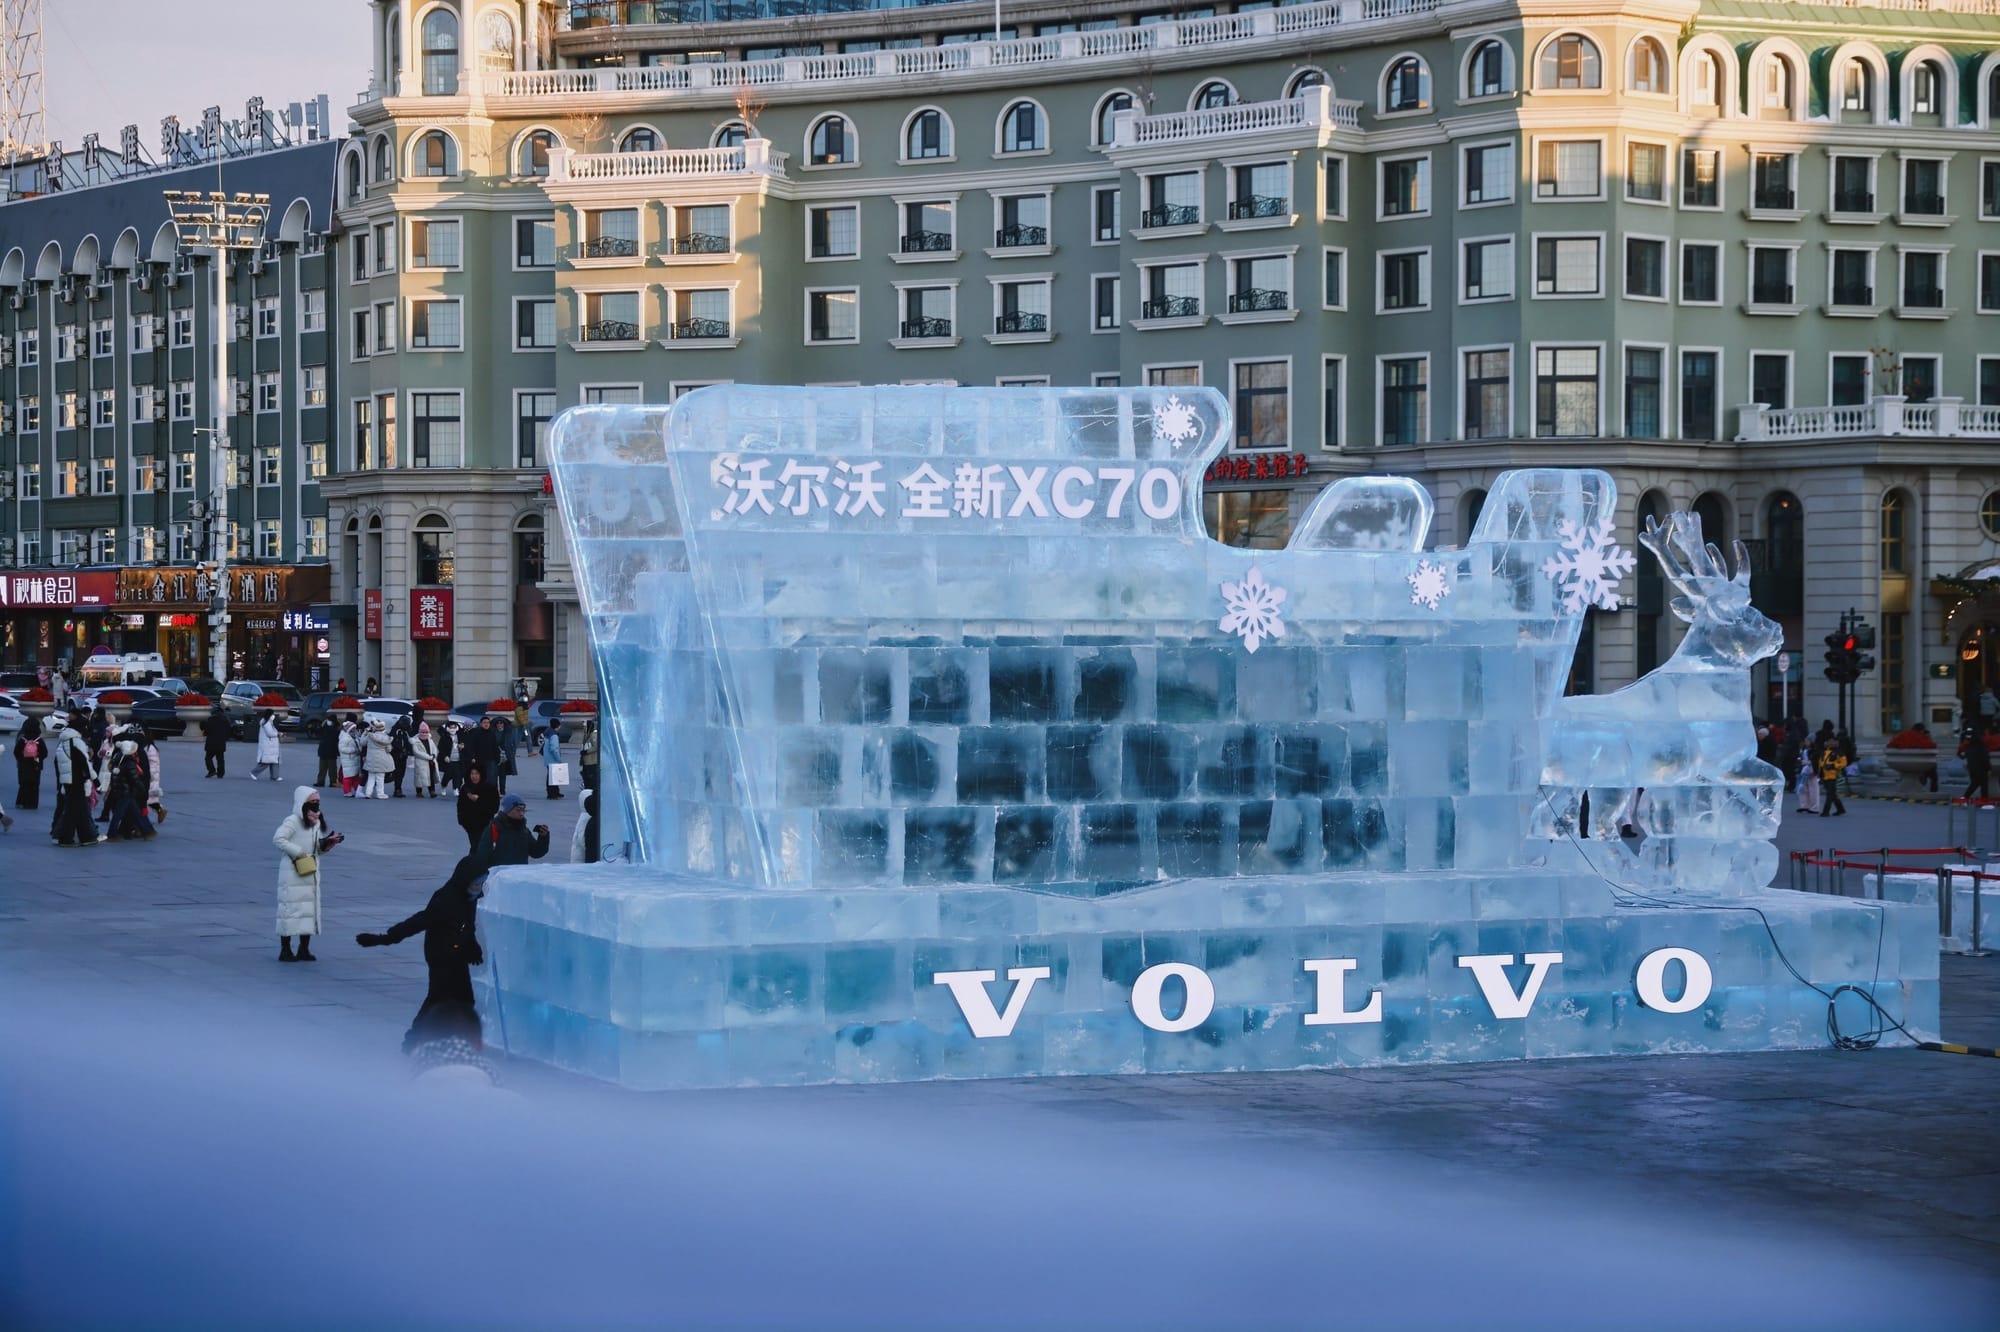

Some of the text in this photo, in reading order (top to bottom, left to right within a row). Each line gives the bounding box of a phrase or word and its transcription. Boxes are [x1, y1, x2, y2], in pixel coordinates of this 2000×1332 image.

[46, 97, 263, 178] 金江雅致酒店
[720, 458, 886, 518] 沃尔沃
[902, 464, 1181, 519] 全新XC70
[15, 577, 72, 604] 秋林食品
[115, 589, 149, 600] HOTEL
[152, 573, 280, 602] 金江雅酒店
[283, 612, 313, 630] 便利店
[420, 595, 437, 628] 棠楂
[933, 946, 1714, 1039] VOLVO
